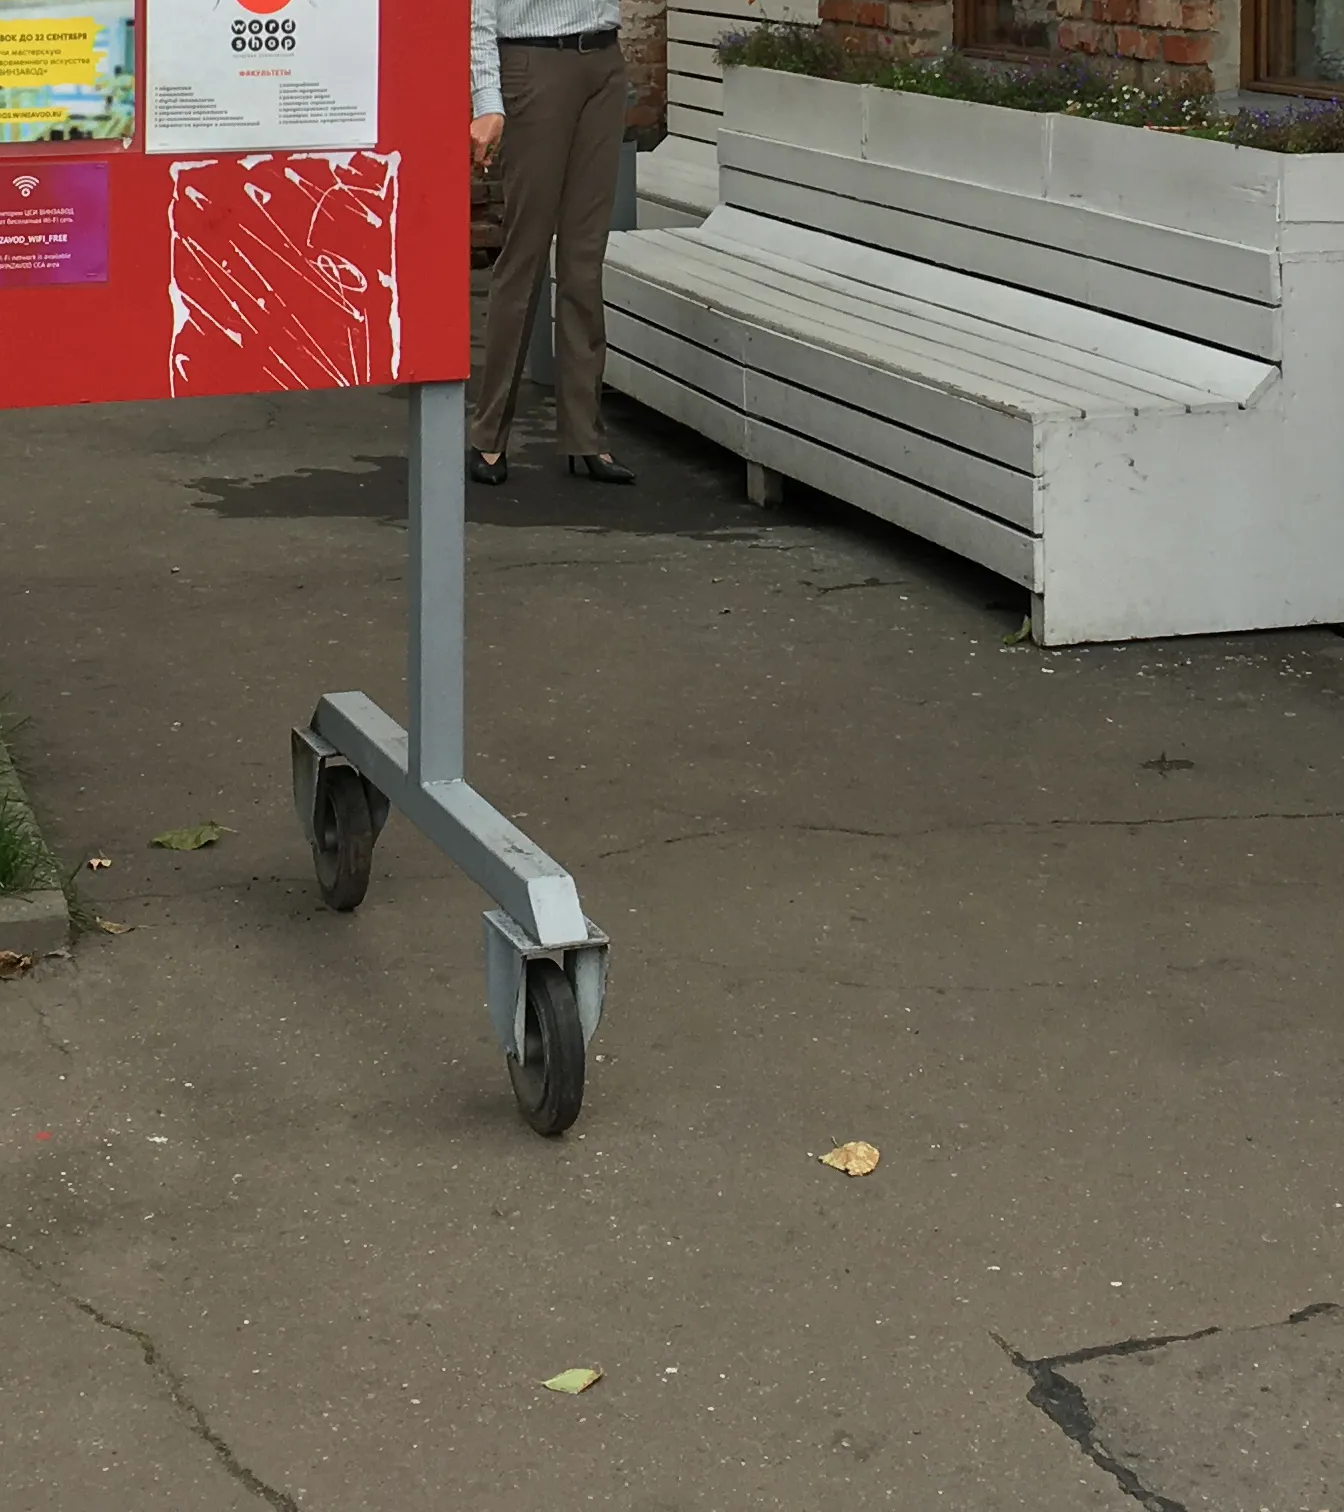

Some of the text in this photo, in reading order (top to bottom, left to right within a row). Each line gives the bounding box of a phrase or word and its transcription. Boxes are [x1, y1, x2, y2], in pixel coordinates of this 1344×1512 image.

[231, 18, 296, 35] word
[19, 33, 33, 43] ДО
[46, 32, 87, 42] СЕНТЯБРЯ
[231, 35, 296, 52] shop
[11, 48, 61, 58] мастерскую
[238, 69, 291, 77] ФАКУЛЬТЕТЫ
